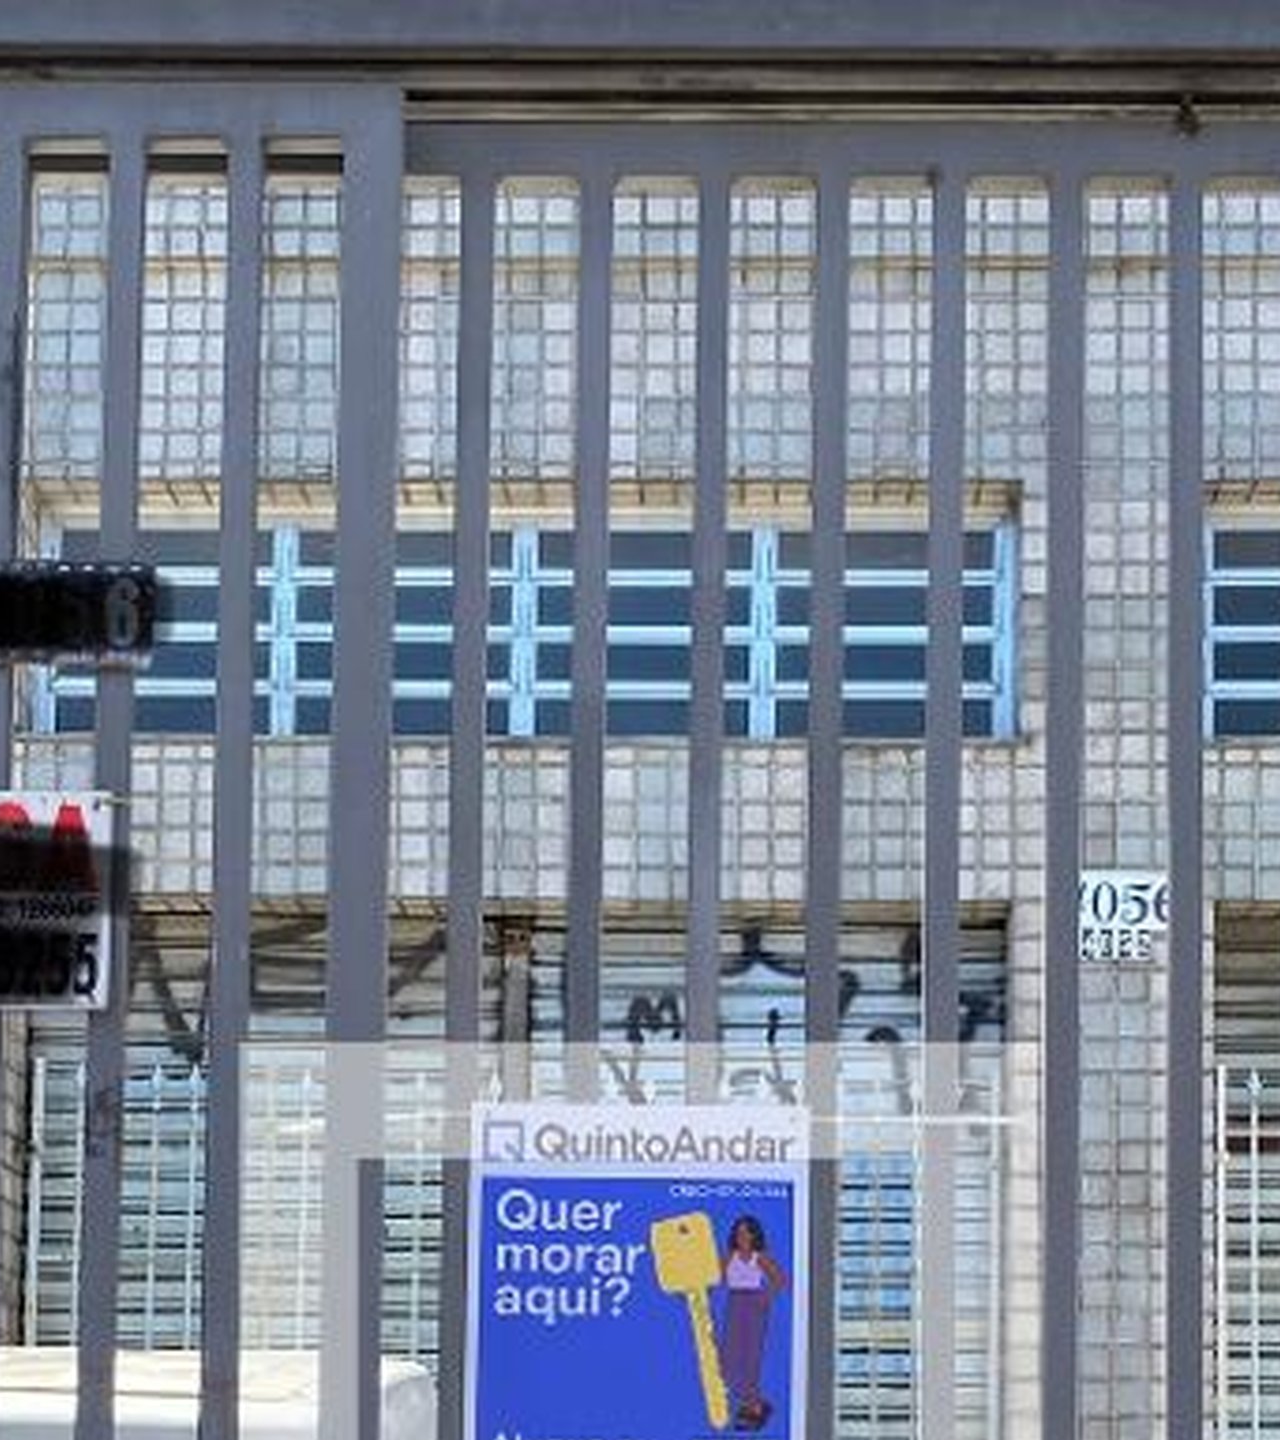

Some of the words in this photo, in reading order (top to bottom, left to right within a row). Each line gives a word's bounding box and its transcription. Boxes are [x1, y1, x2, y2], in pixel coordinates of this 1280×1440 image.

[534, 1123, 794, 1164] QuintoAndar
[497, 1189, 623, 1232] Quer
[496, 1243, 646, 1275] morar
[494, 1277, 631, 1325] aqui?
